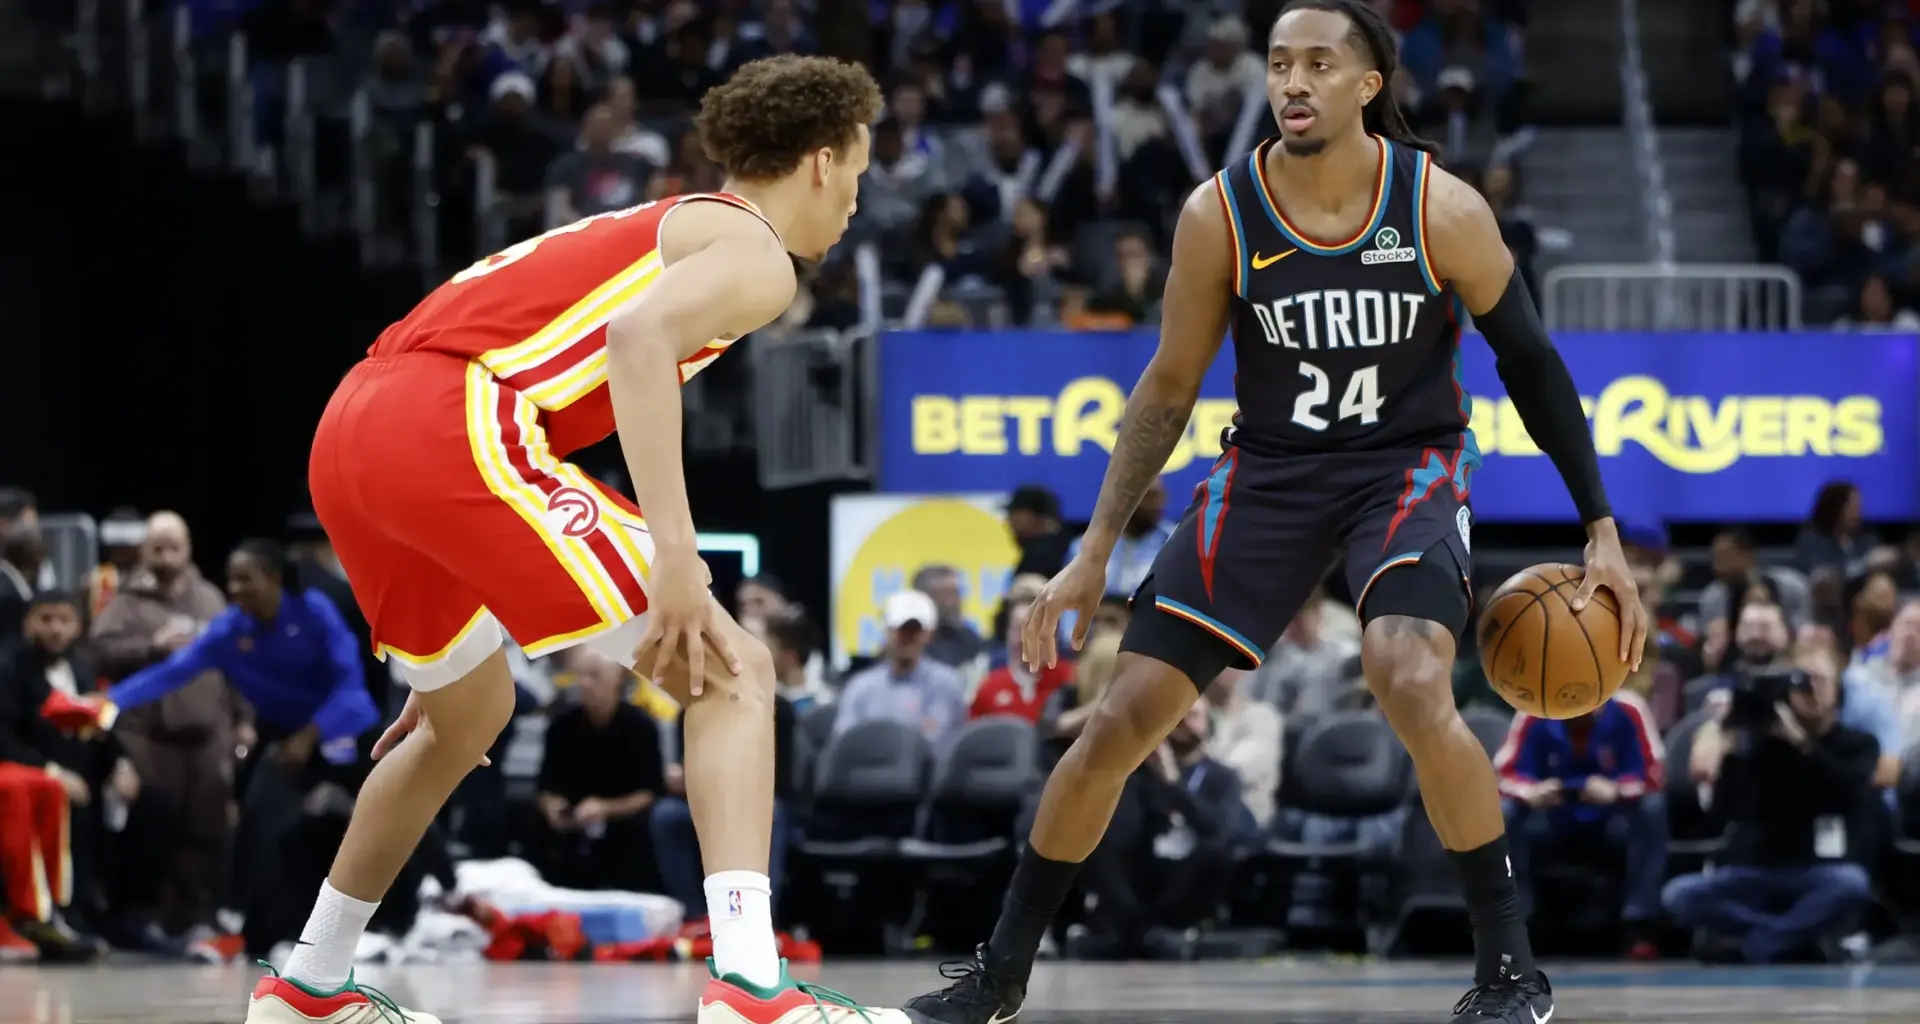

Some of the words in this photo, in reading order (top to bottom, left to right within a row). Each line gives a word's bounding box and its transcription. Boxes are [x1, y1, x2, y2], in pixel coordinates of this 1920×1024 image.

[1363, 249, 1413, 263] StockX
[1252, 289, 1426, 350] DETROIT
[1290, 361, 1388, 431] 24
